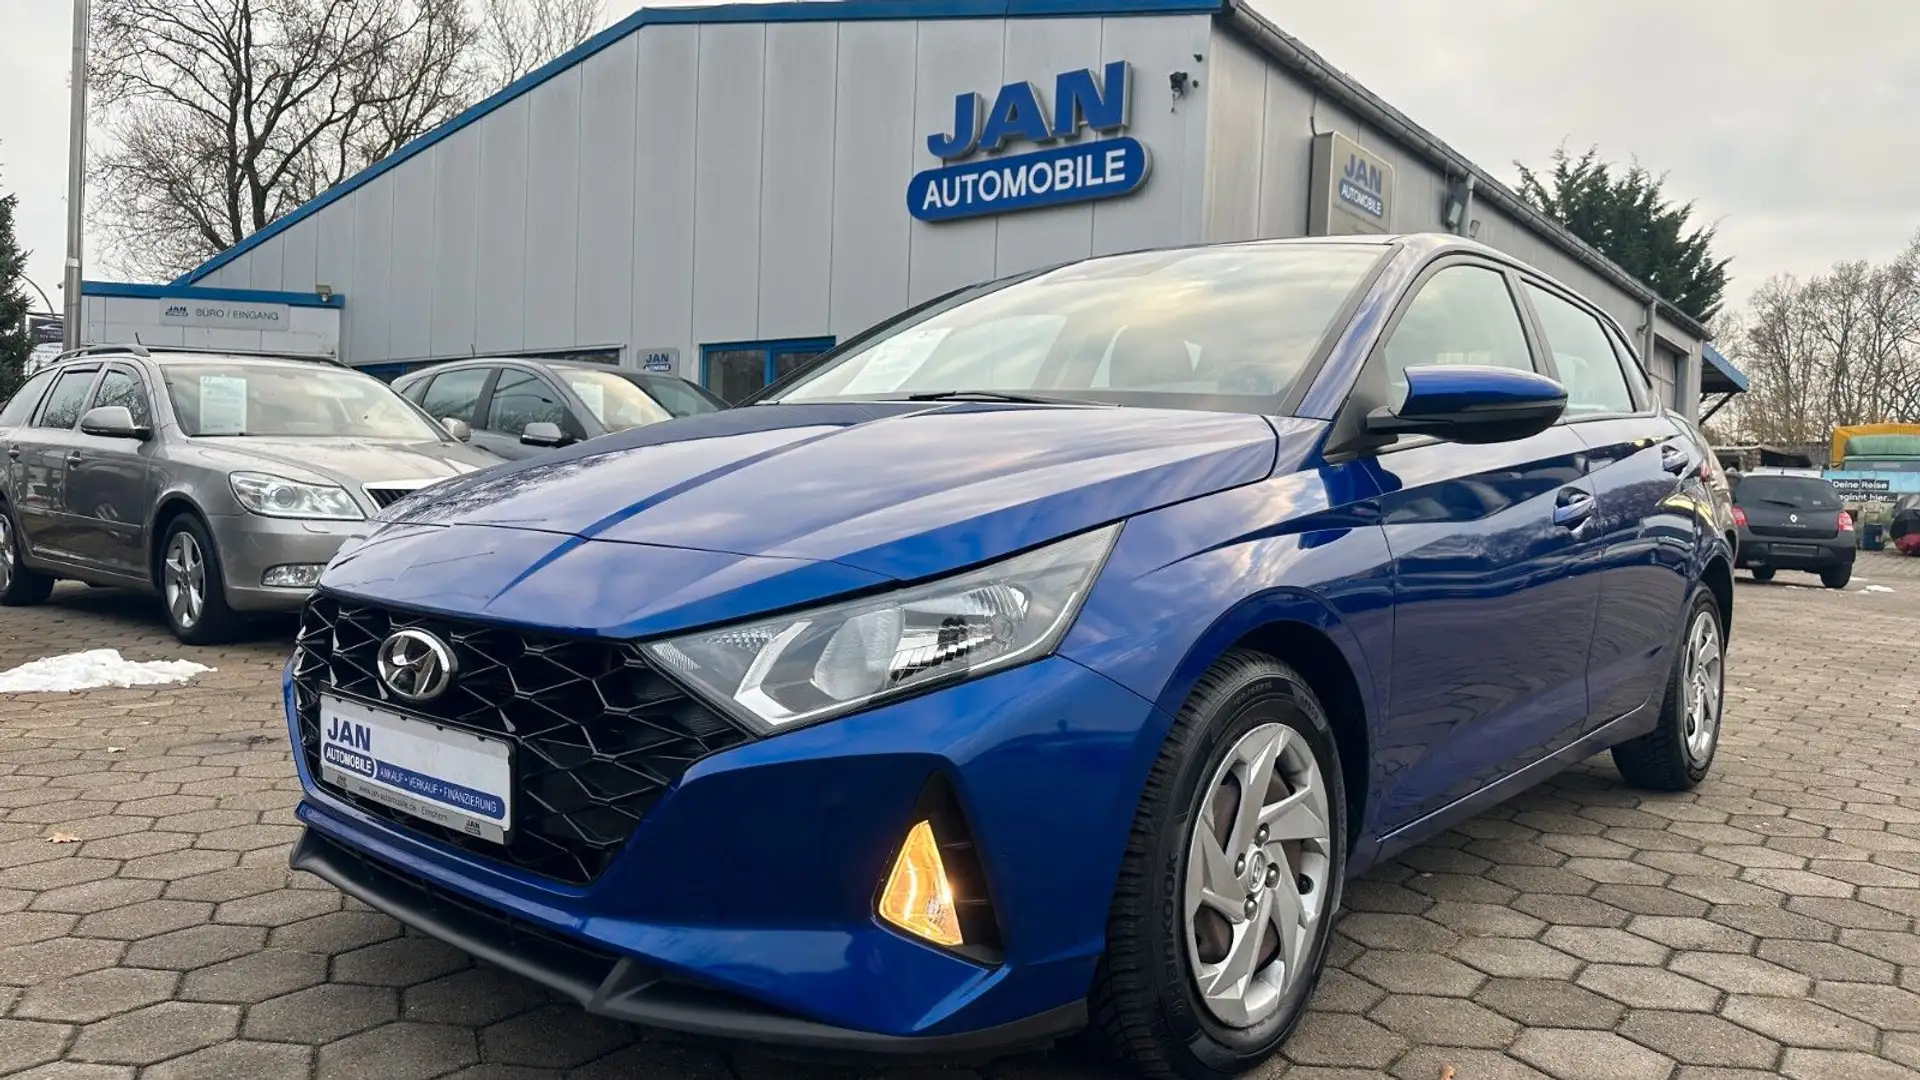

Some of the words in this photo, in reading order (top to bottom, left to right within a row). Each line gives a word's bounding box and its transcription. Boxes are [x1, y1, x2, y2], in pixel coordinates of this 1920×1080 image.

[927, 60, 1130, 158] JAN
[922, 148, 1126, 210] AUTOMOBILE
[1344, 153, 1382, 195] JAN
[1341, 183, 1382, 216] AUTOMOBILE
[196, 308, 224, 318] BÜRO
[233, 310, 279, 320] EINGANG
[646, 353, 669, 363] JAN
[1832, 481, 1859, 489] Deine
[1861, 481, 1887, 489] Reise
[1839, 493, 1867, 502] eginnt
[327, 716, 371, 752] JAN
[326, 746, 372, 774] AUTOMOBILE
[380, 767, 403, 782] ANKAUF
[408, 774, 438, 794] VERKAUF
[443, 786, 498, 813] FINANZIERUNG
